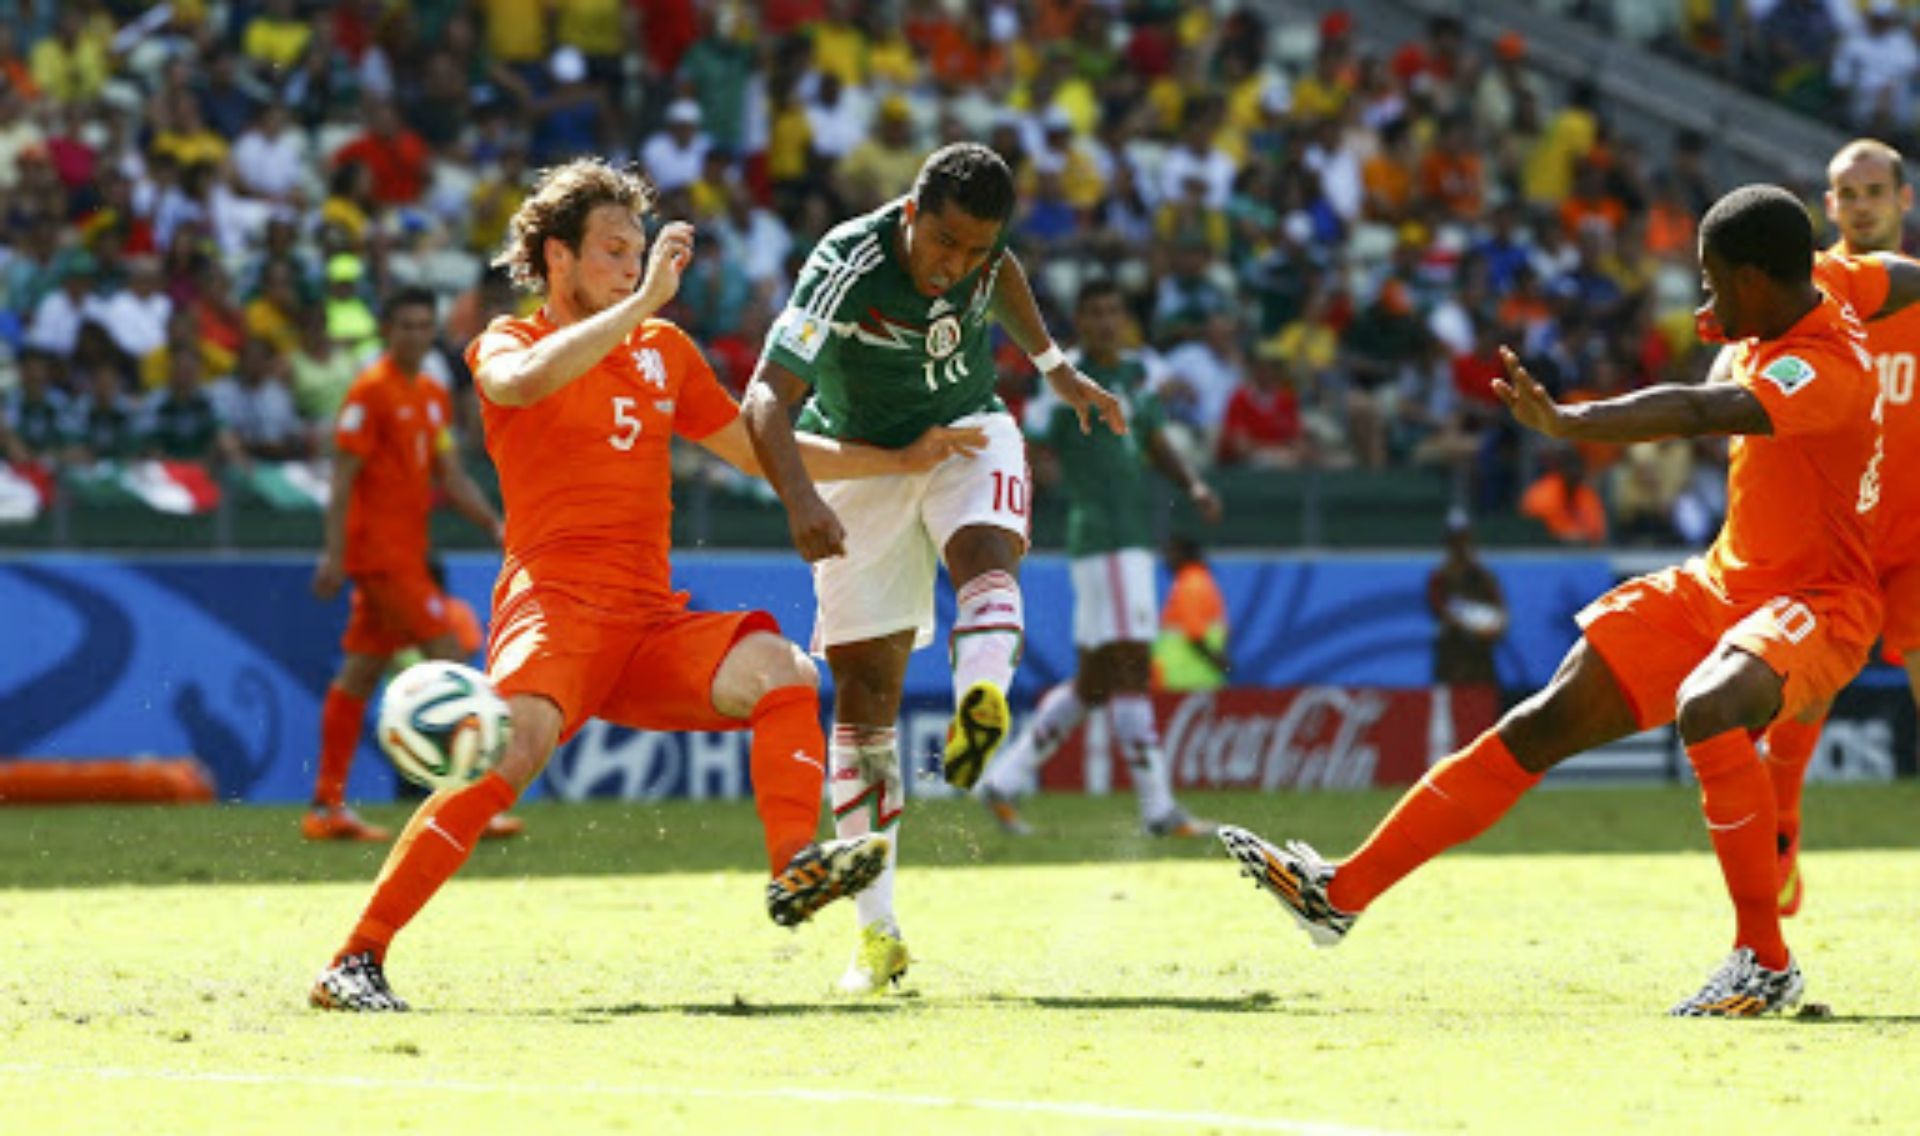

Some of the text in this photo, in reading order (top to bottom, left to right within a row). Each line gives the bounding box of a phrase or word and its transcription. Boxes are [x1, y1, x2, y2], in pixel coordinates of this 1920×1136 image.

[1875, 353, 1916, 404] 10
[609, 396, 642, 451] 5
[990, 469, 1026, 516] 10
